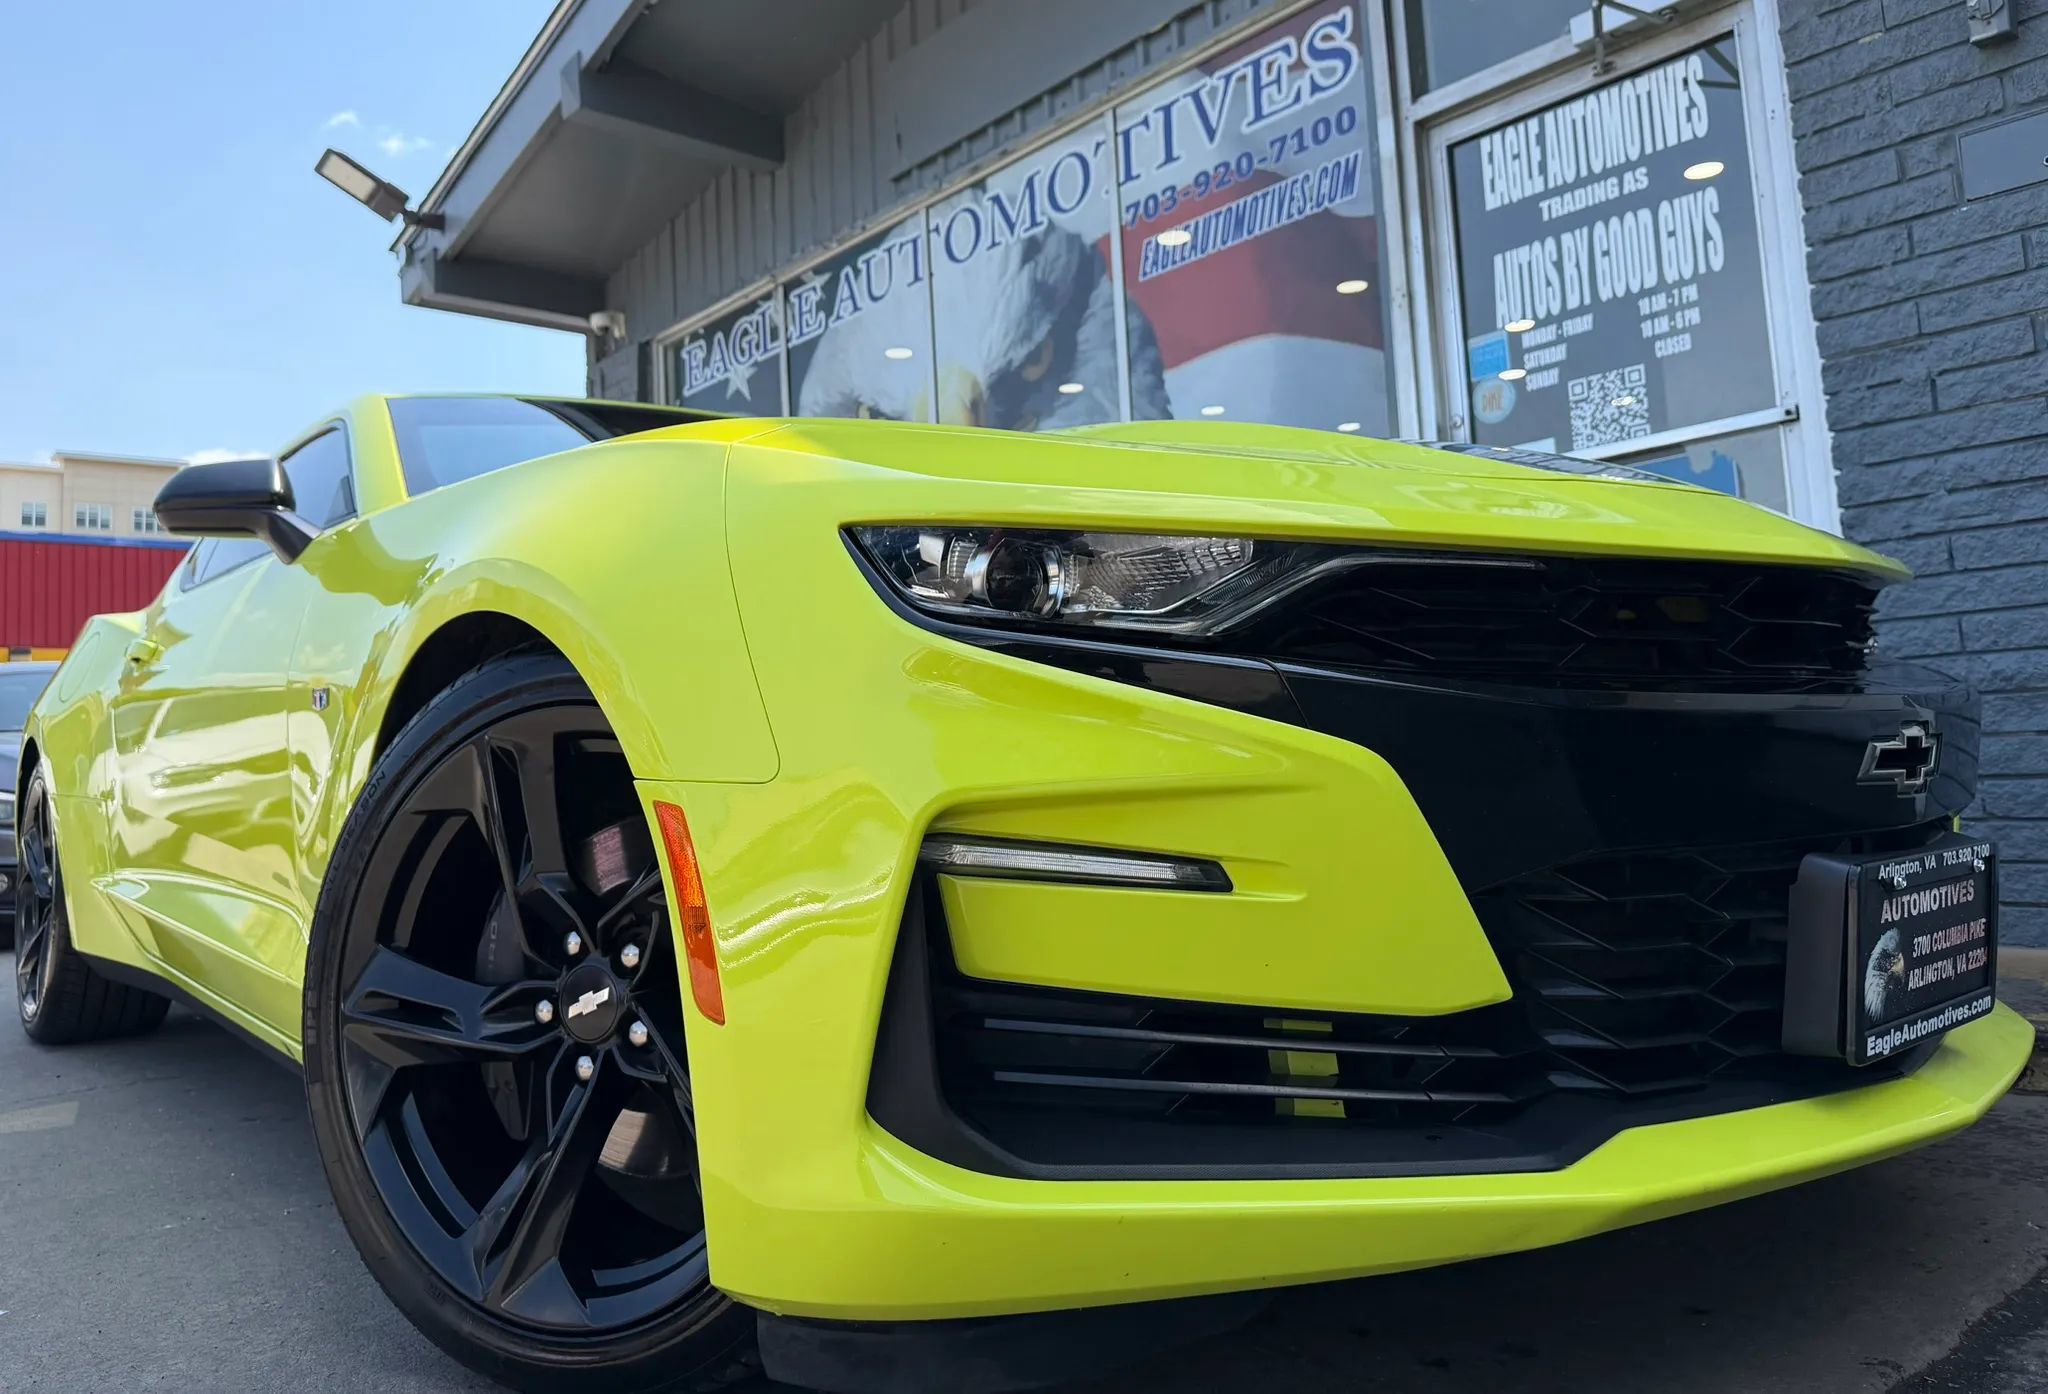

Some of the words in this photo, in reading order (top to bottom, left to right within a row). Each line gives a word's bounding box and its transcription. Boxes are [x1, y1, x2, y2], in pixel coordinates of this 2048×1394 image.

[1479, 115, 1544, 211] EAGLE
[1544, 54, 1709, 189] AUTOMOTIVES
[1126, 105, 1356, 228] 703-920-7100
[684, 285, 825, 395] EAGLE
[829, 7, 1358, 327] AUTOMOTIVES
[1139, 151, 1361, 281] EAGLEAUTOMOTIVES.COM
[1538, 177, 1620, 222] TRADING
[1622, 166, 1649, 195] AS
[1493, 236, 1562, 329] AUTOS
[1560, 225, 1591, 310] BY
[1592, 207, 1658, 302] GOOD
[1657, 186, 1725, 284] GUYS
[1523, 342, 1567, 370] SATURDAY
[1655, 332, 1692, 358] CLOSED
[1525, 367, 1559, 392] SUNDAY
[1878, 860, 1922, 880] Arlington,
[1924, 855, 1936, 870] VA
[1943, 843, 1990, 866] 703.920.7100
[1880, 879, 1975, 923] AUTOMOTIVES
[1913, 934, 1931, 958] 3700
[1932, 923, 1968, 952] COLUMBIA
[1969, 918, 1986, 941] PIKE
[1908, 957, 1955, 991] ARLINGTON,
[1957, 953, 1967, 974] VA
[1866, 995, 1991, 1057] EagleAutomotives.com
